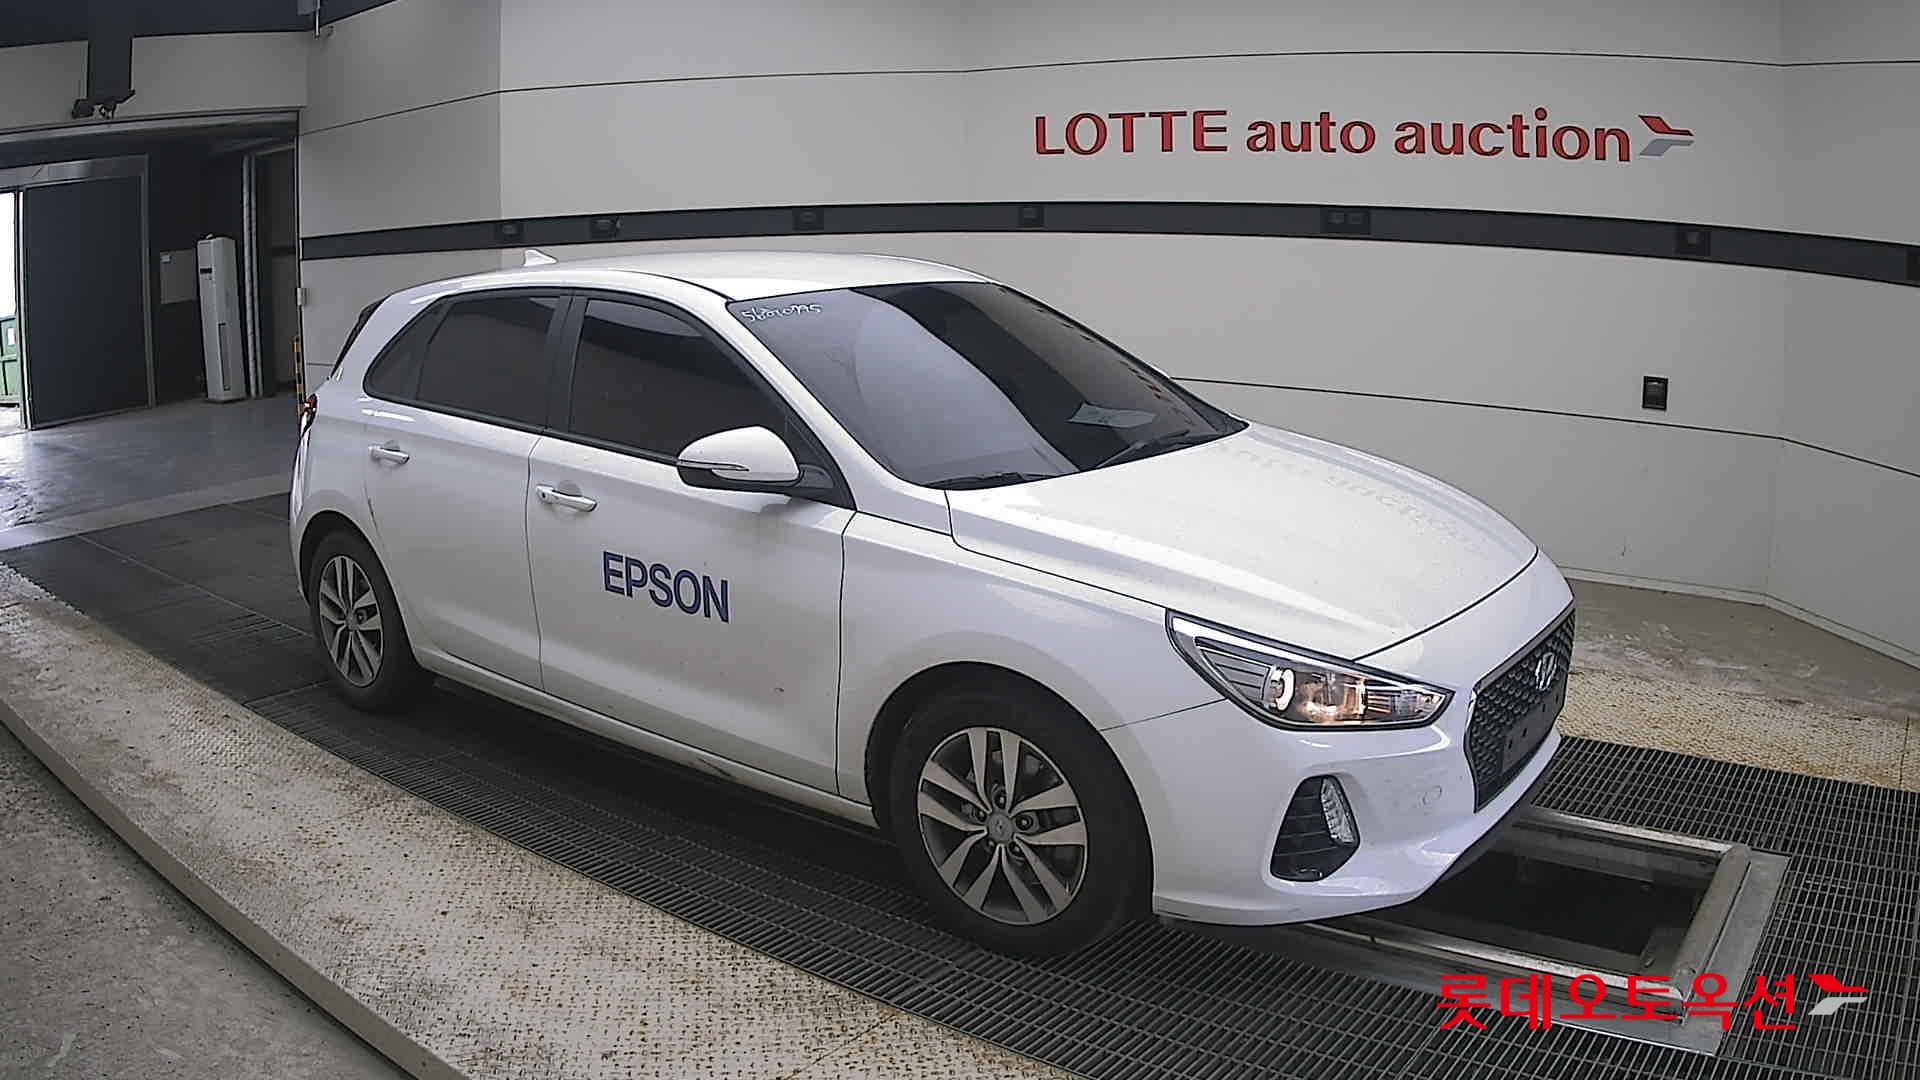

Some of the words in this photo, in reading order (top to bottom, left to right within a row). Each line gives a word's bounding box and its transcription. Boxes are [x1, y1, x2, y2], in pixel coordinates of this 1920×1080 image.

[1035, 111, 1227, 157] LOTTE
[1247, 112, 1376, 154] auto
[1394, 108, 1632, 162] auction
[604, 551, 729, 624] EPSON
